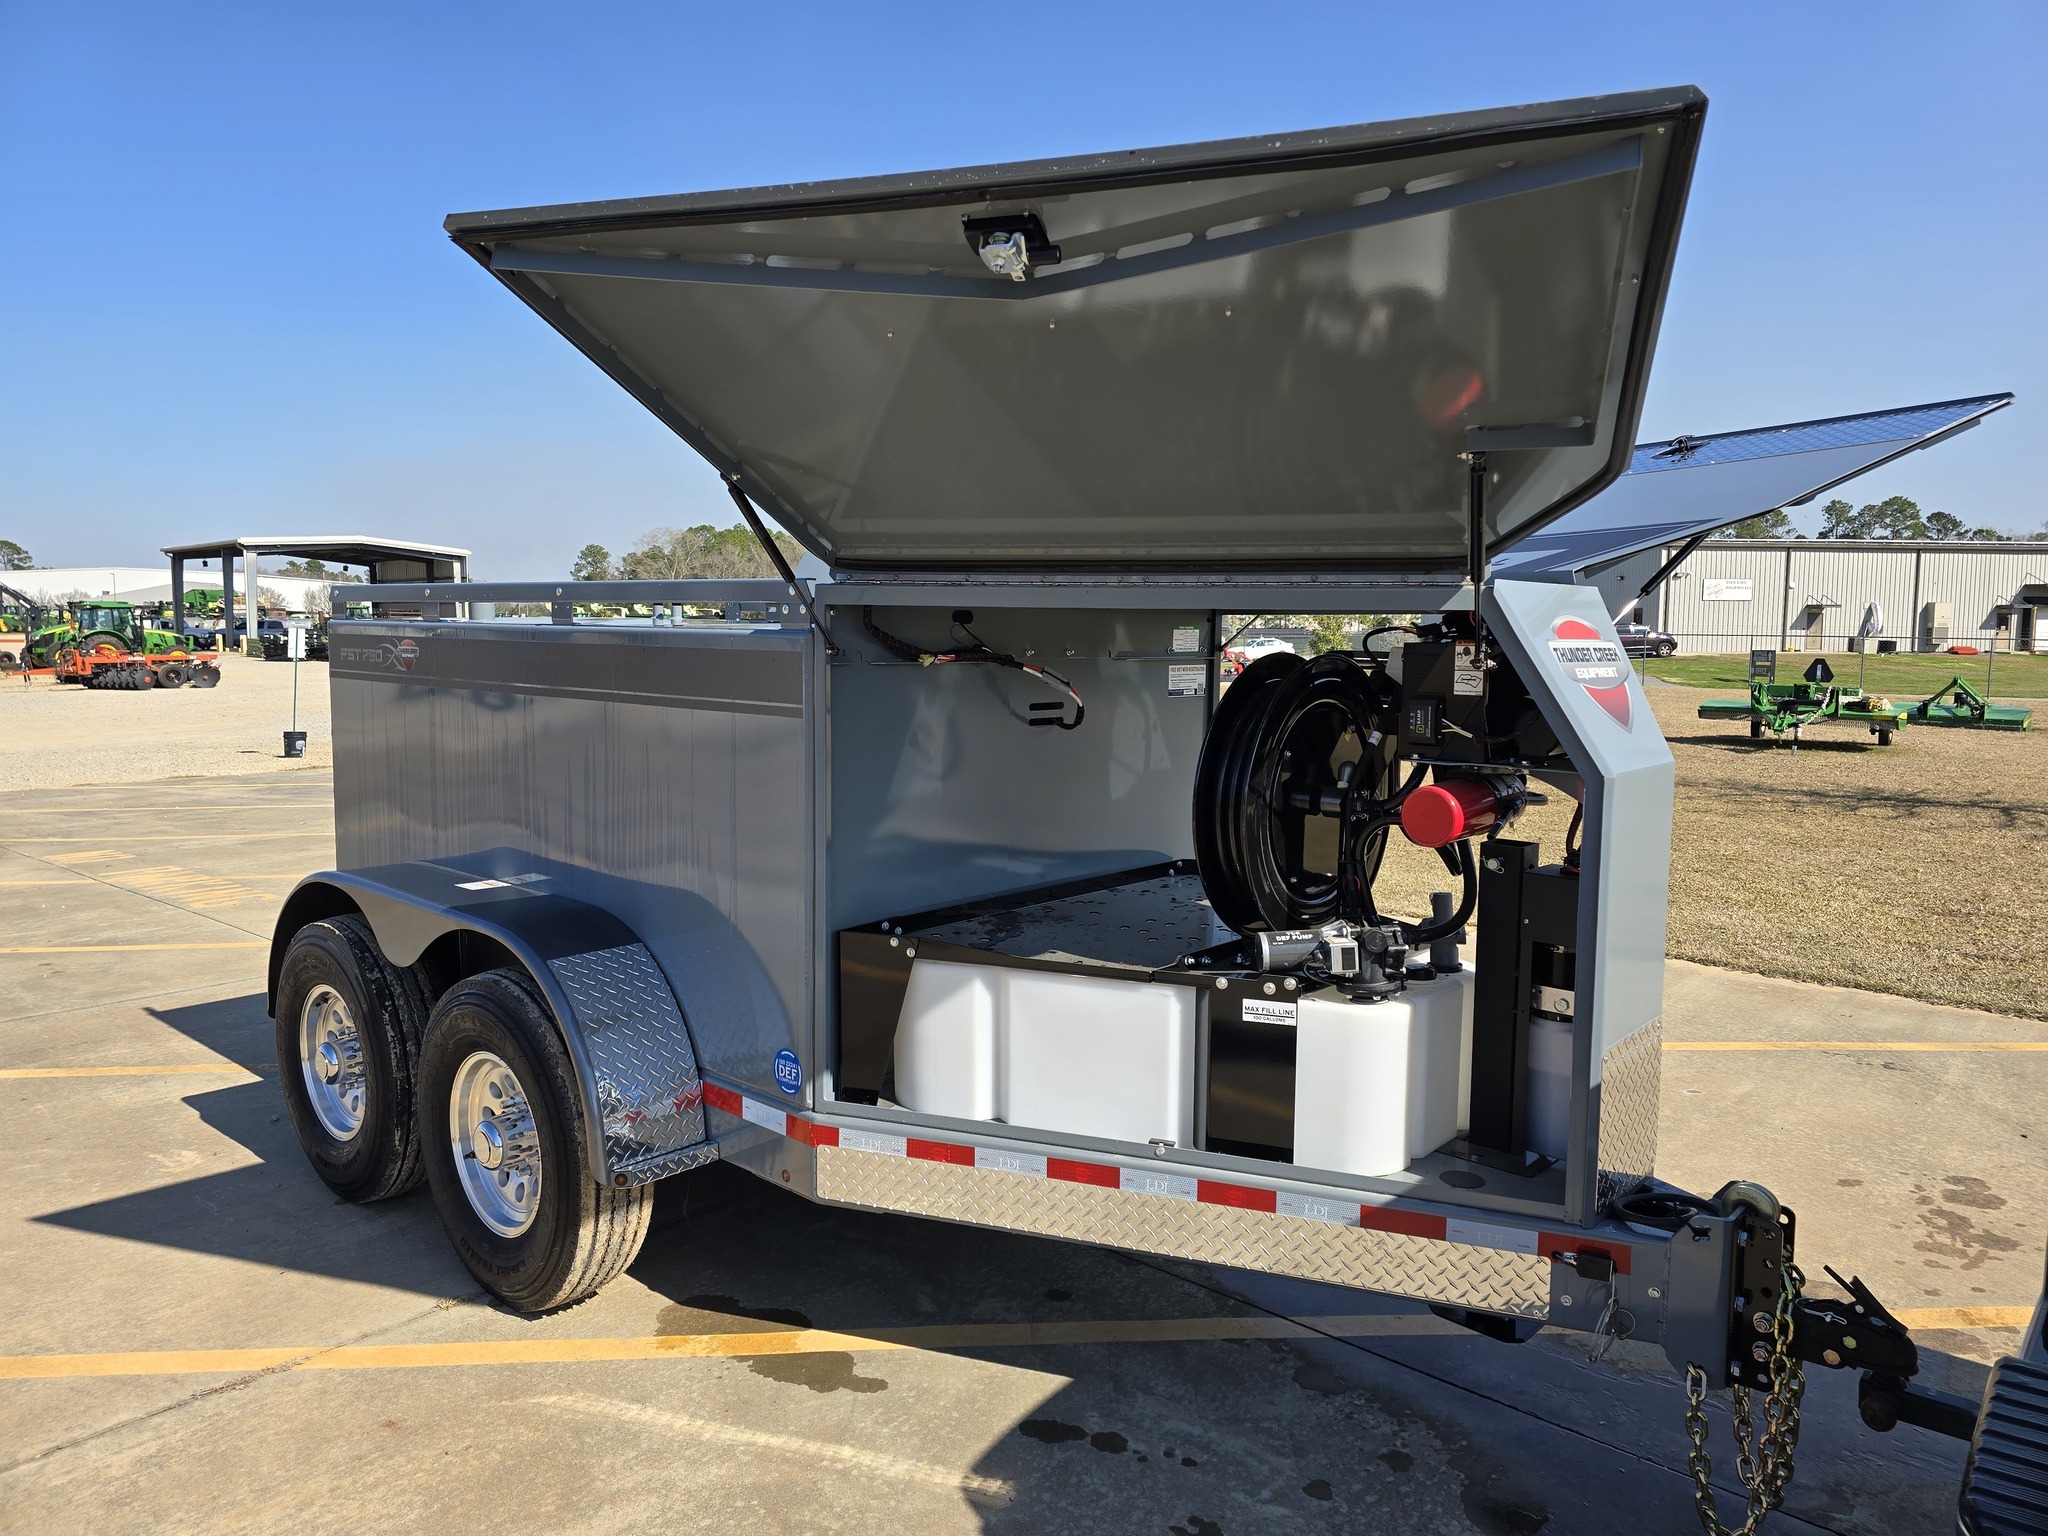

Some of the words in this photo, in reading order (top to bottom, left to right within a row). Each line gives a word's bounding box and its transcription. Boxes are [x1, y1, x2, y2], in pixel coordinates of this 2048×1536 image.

[1552, 647, 1595, 663] THUNDER
[1593, 648, 1622, 663] CREEK
[1574, 666, 1618, 679] EQUIPMENT
[779, 1064, 797, 1080] DEF
[779, 1076, 798, 1086] COMPLIANT
[999, 1157, 1019, 1172] LDJ
[1146, 1178, 1168, 1194] LDJ
[1304, 1204, 1329, 1220] LDJ
